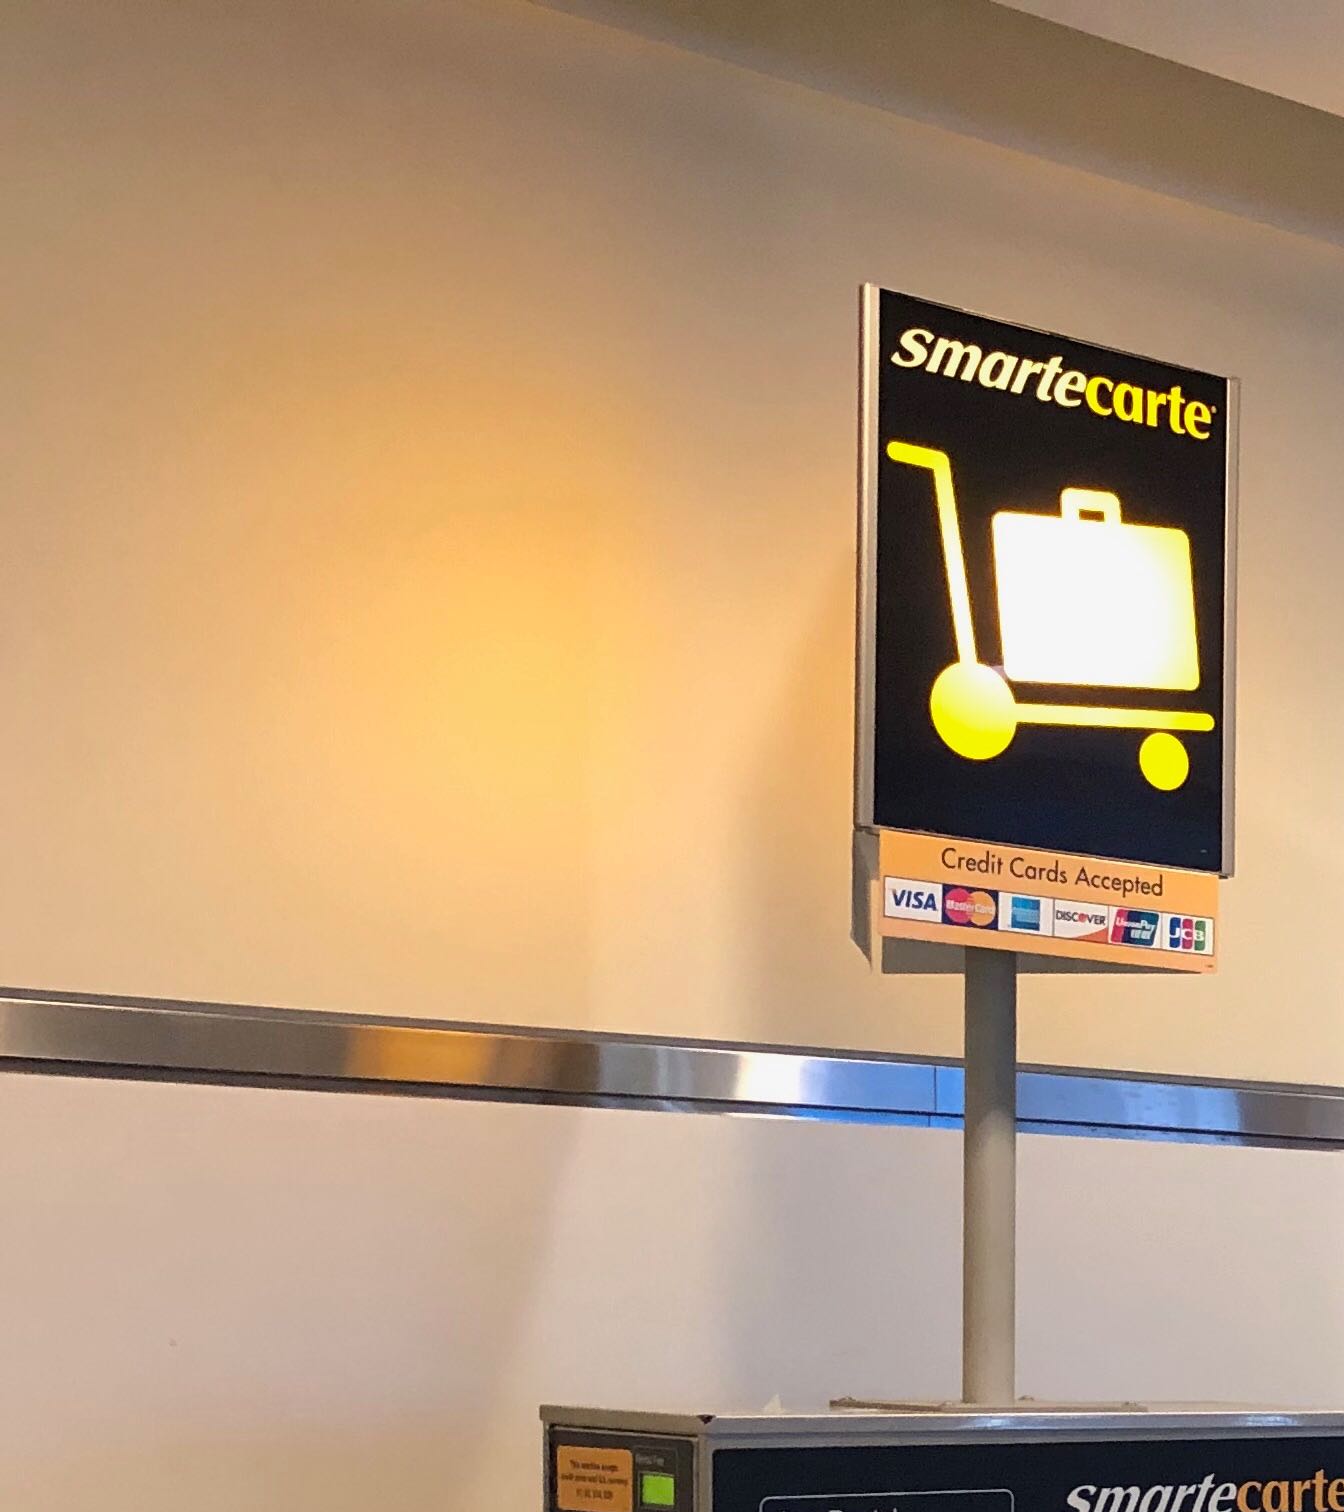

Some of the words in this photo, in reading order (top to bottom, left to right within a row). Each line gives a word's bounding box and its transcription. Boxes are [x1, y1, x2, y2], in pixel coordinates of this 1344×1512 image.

[890, 328, 1213, 440] smartecarte
[941, 847, 1003, 875] Credit
[1009, 857, 1068, 884] Cards
[1074, 867, 1164, 897] Accepted
[891, 888, 938, 912] VISA
[1056, 909, 1106, 926] DISCOVER
[1168, 925, 1206, 943] JCB
